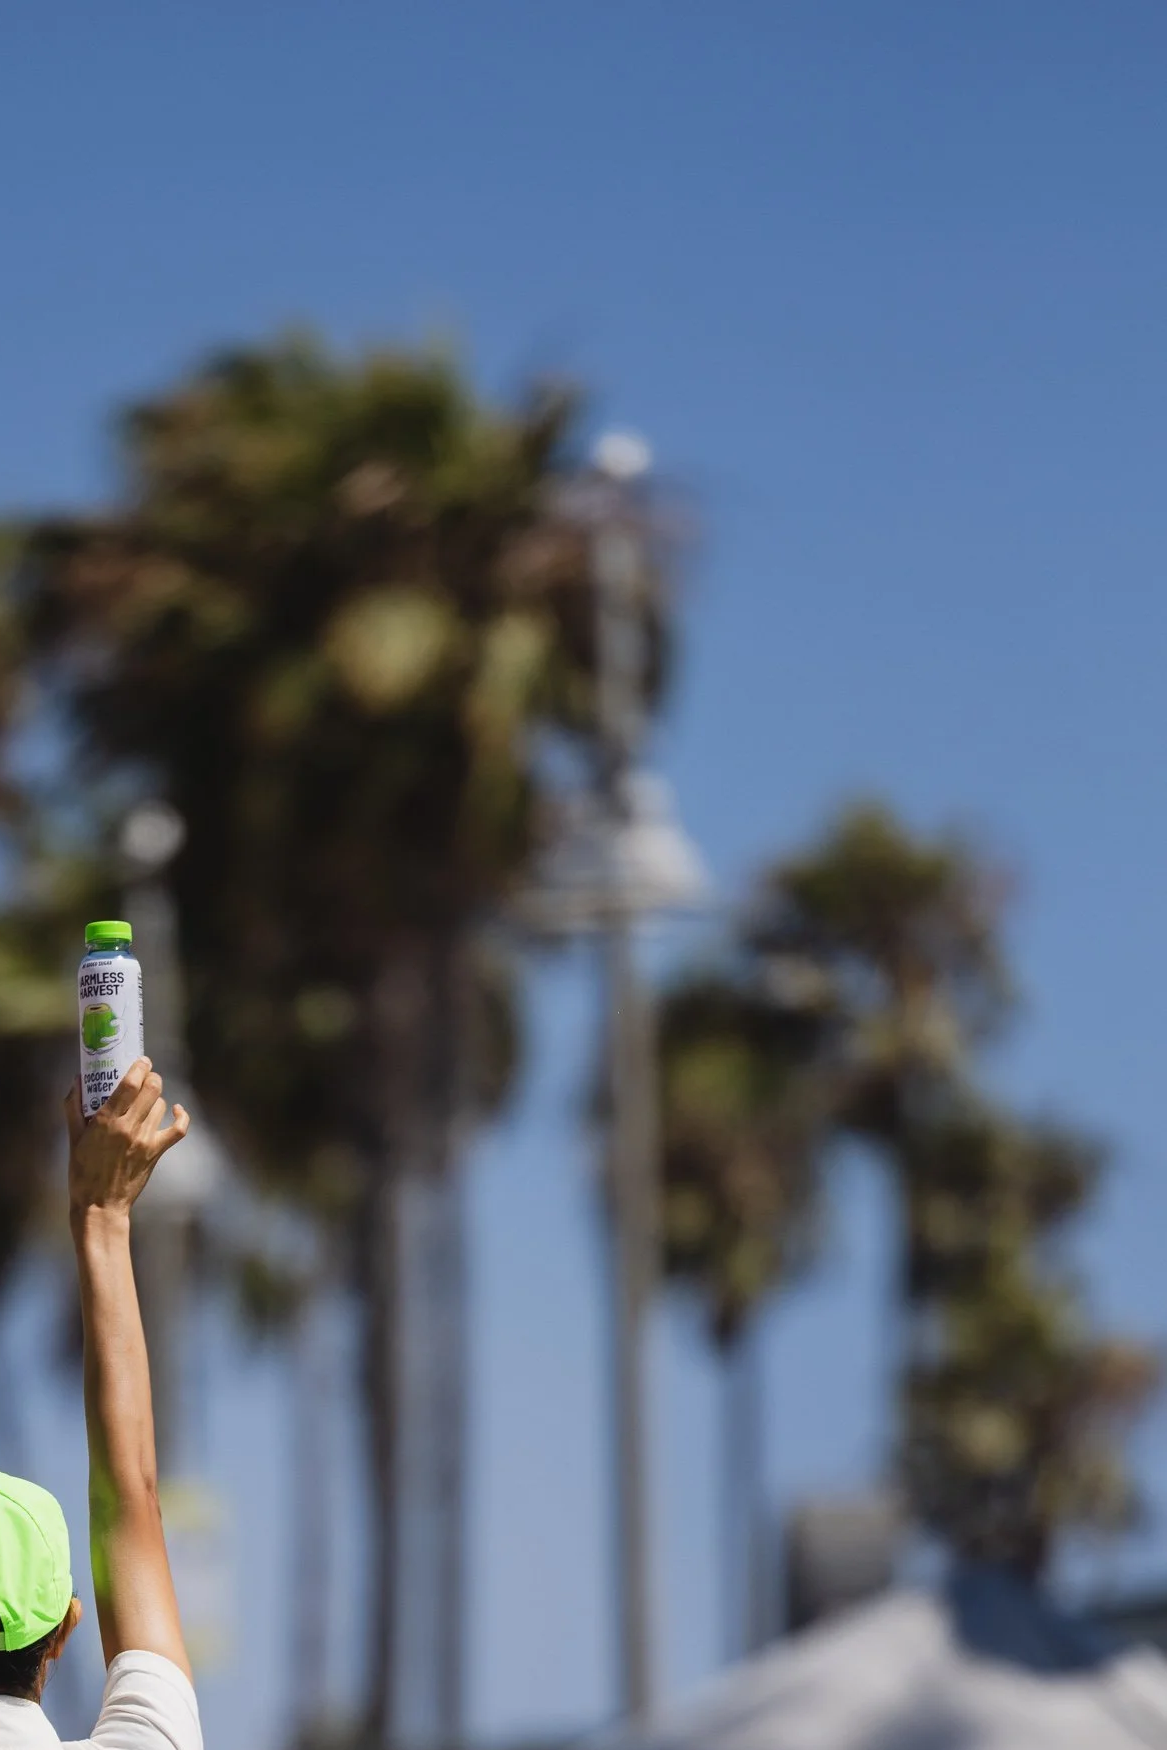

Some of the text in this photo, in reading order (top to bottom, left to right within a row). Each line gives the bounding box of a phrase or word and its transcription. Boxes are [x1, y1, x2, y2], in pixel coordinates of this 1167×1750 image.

[80, 972, 124, 987] ARMLESS
[84, 1068, 119, 1084] coconut
[86, 1081, 114, 1094] water
